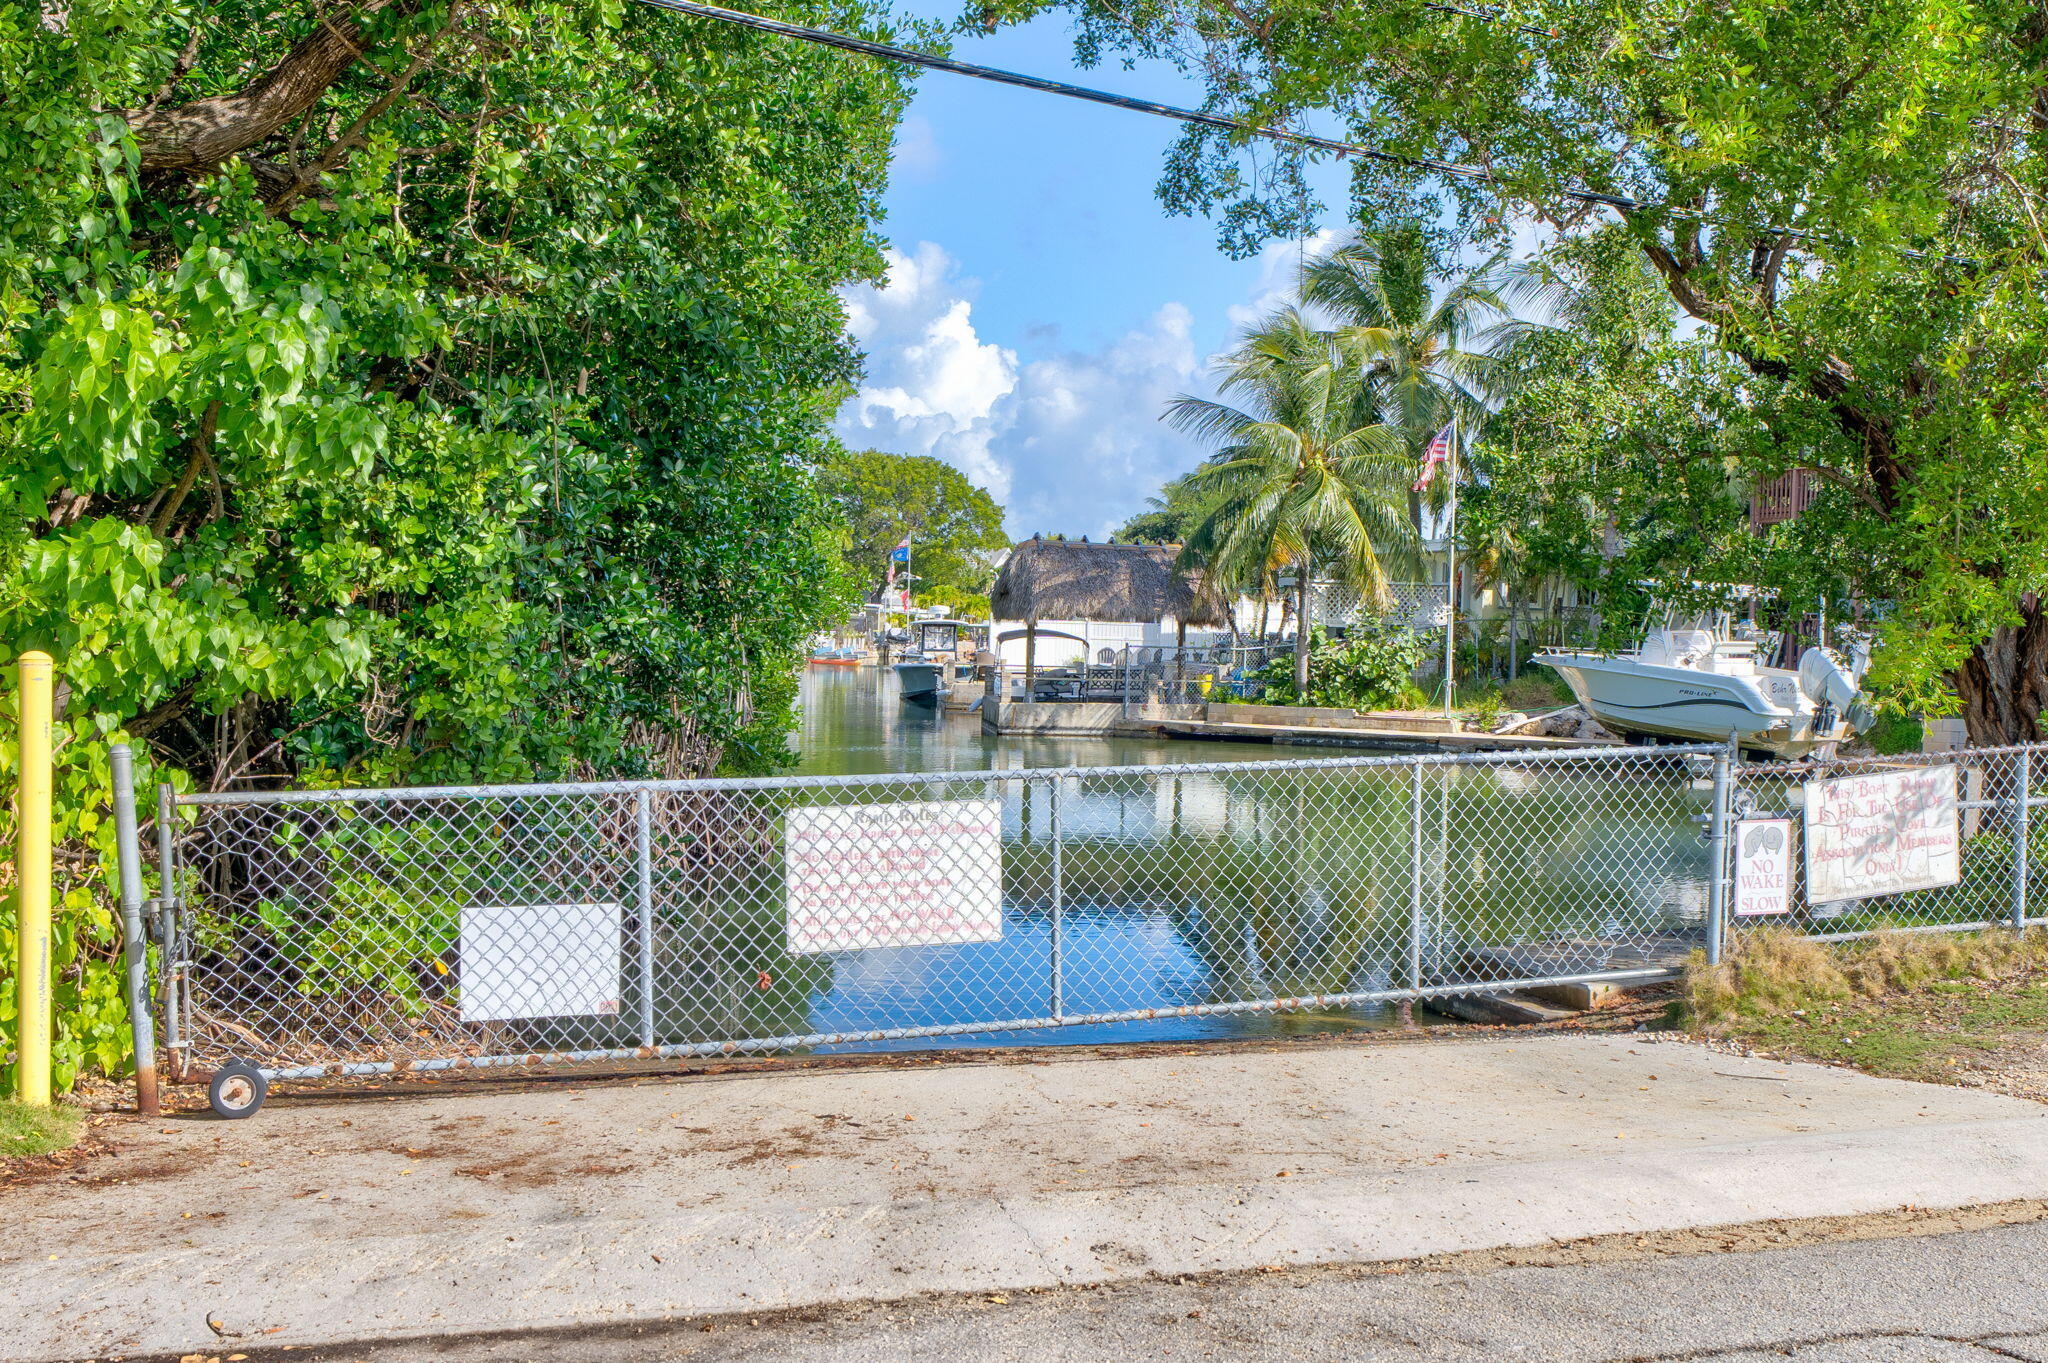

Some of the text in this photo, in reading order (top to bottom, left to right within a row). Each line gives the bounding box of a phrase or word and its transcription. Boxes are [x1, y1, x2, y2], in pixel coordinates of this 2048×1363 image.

[1752, 859, 1774, 874] NO
[1741, 874, 1784, 889] WAKE
[1741, 896, 1782, 911] SLOW
